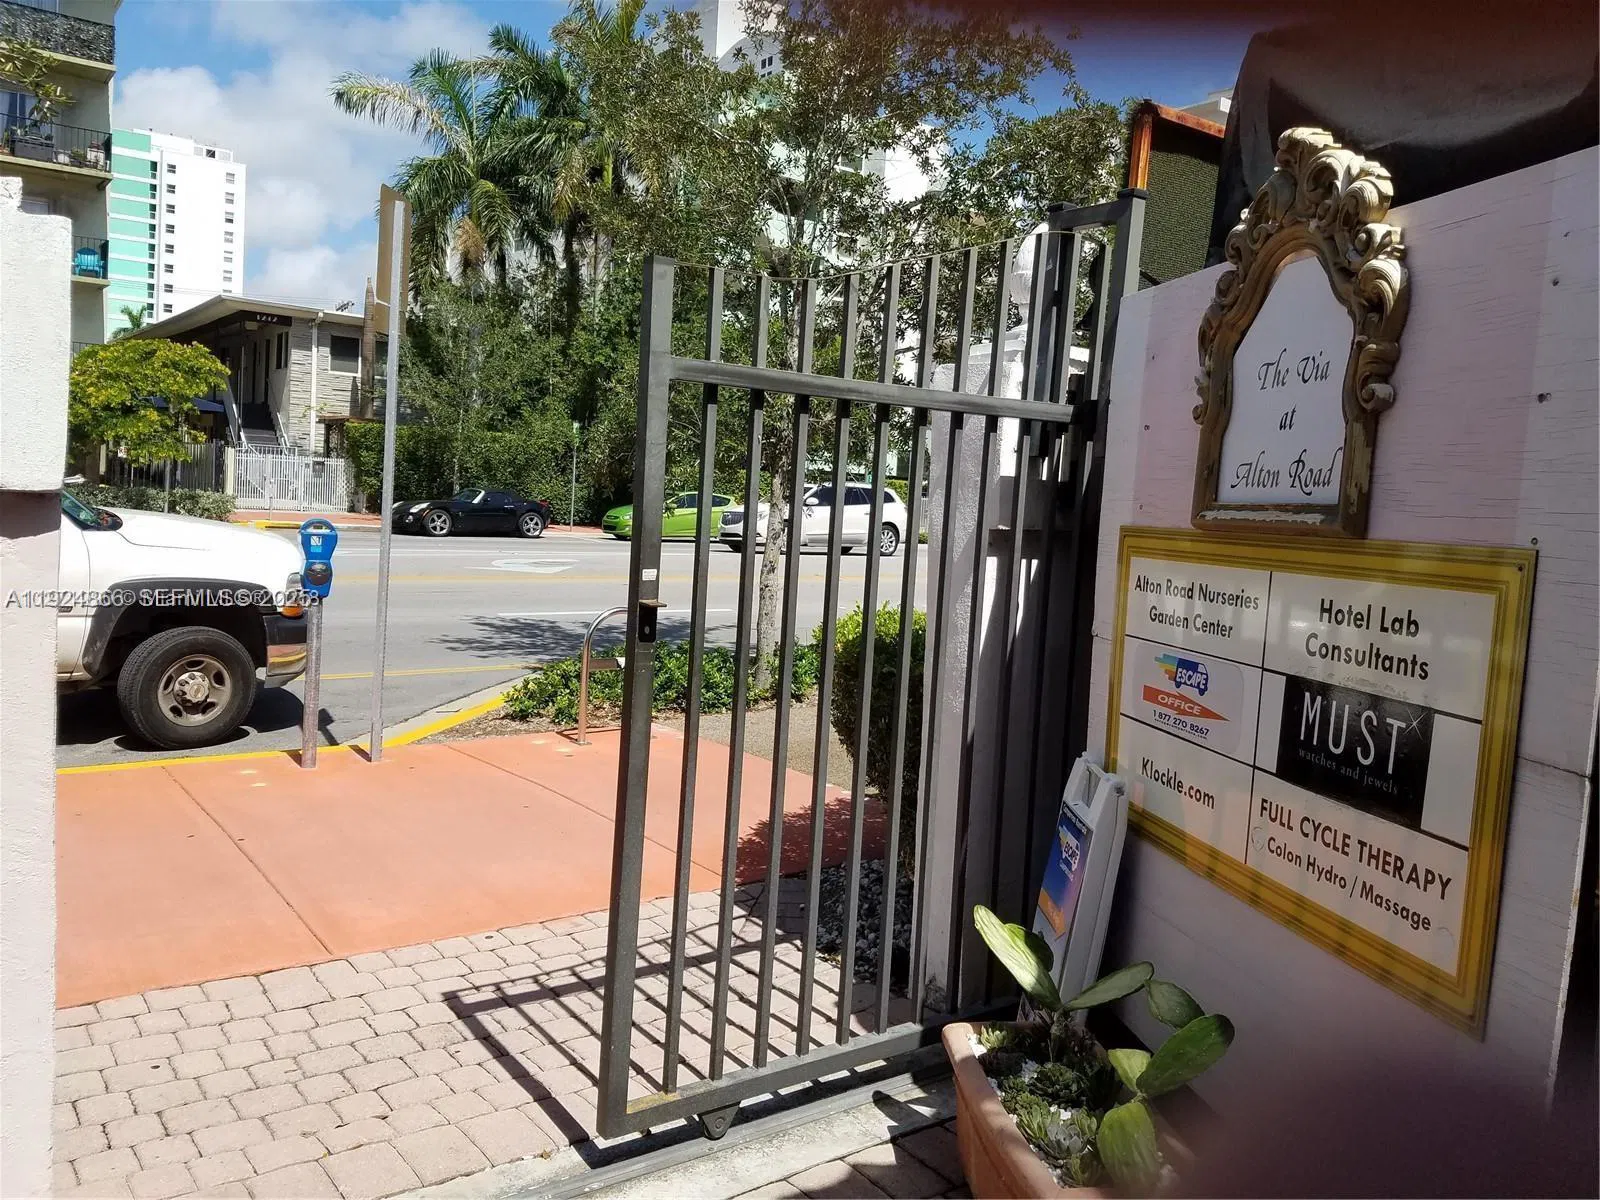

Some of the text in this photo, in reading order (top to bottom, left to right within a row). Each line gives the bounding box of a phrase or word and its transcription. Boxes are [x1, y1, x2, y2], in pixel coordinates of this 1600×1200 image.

[1258, 348, 1330, 391] The Via
[1279, 404, 1297, 431] at
[1230, 446, 1343, 496] Alton Road
[1134, 575, 1259, 611] Alton Road Nurseries
[1149, 605, 1233, 639] Garden Center
[1319, 598, 1420, 638] Hotel Lab
[1305, 632, 1430, 681] Consultants
[1176, 667, 1207, 690] ESCAPE
[1153, 709, 1157, 718] 1
[1158, 711, 1171, 722] 877
[1173, 717, 1188, 729] 270
[1189, 723, 1210, 737] 8267
[1157, 694, 1202, 715] OFFICE
[1300, 691, 1407, 775] MUST
[1141, 757, 1215, 810] Klockle.com
[1299, 748, 1398, 795] watches and jewels
[1259, 797, 1452, 900] FULL CYCLE THERAPY
[1267, 836, 1432, 931] Colon Hydro / Massage
